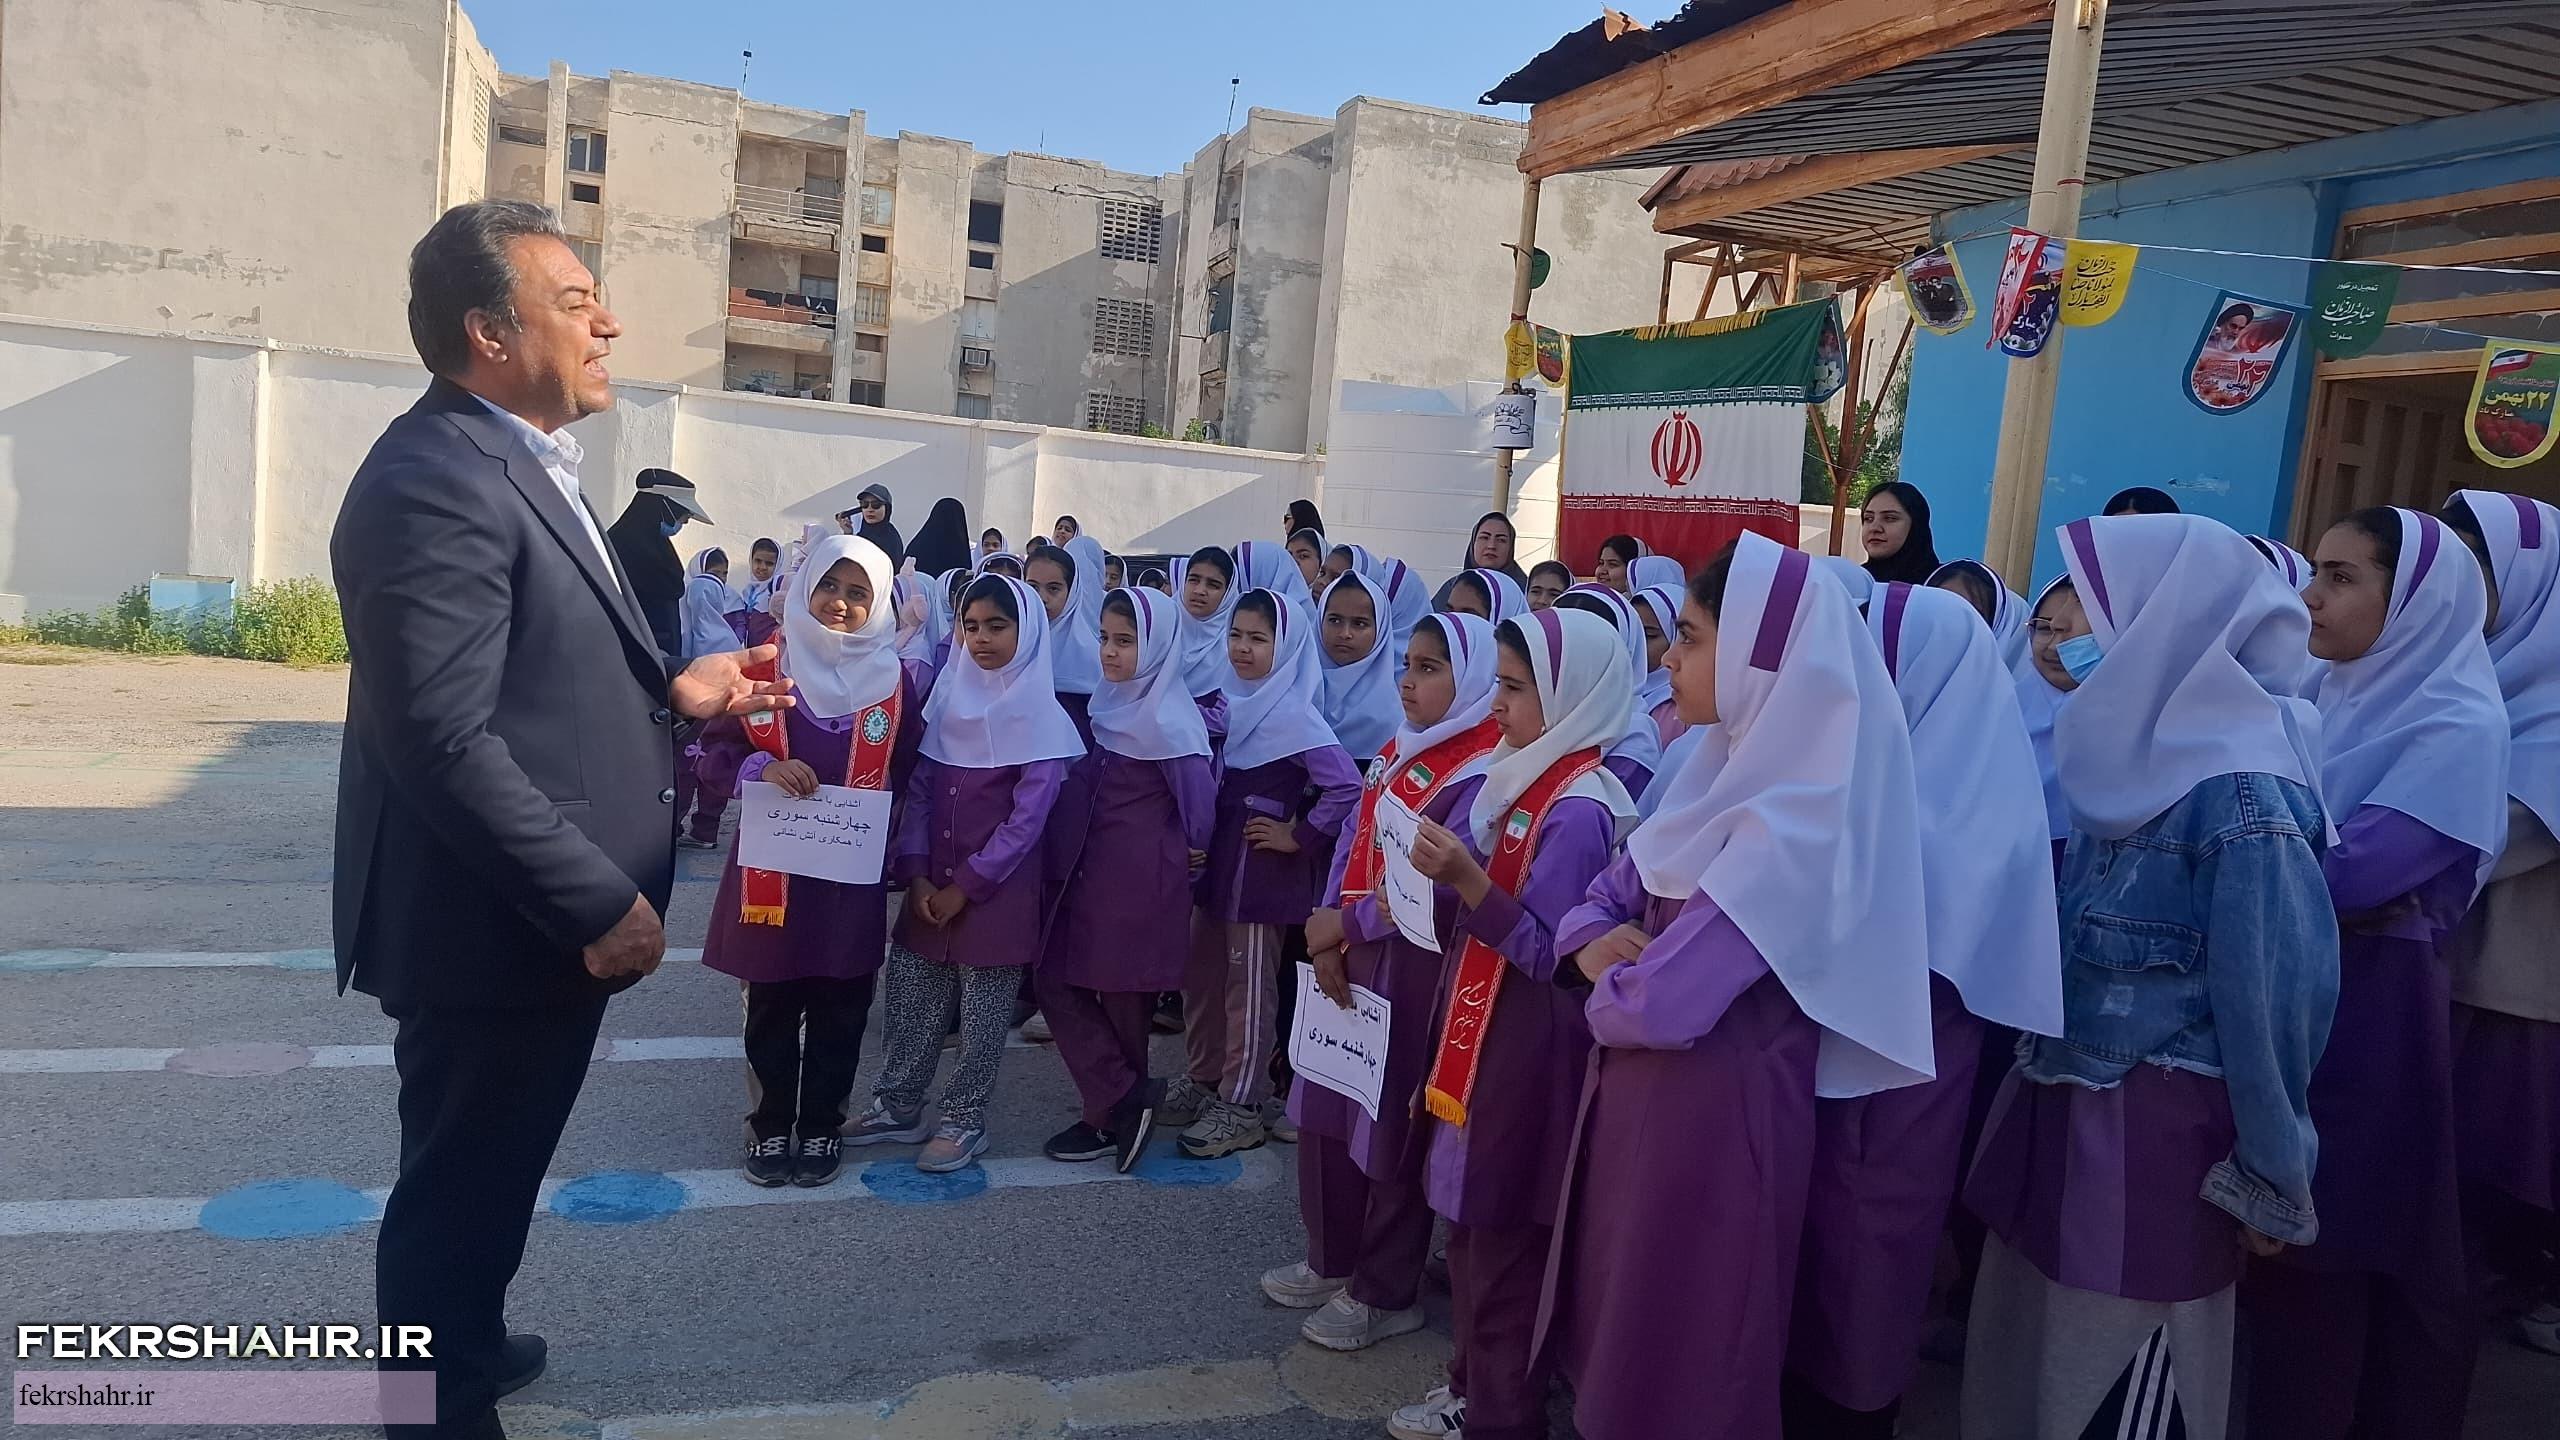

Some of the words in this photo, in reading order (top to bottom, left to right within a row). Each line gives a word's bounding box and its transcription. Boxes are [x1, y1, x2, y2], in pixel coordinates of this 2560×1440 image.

[2485, 390, 2525, 408] بهمن
[2527, 390, 2551, 410] ۲۲
[767, 808, 809, 822] سوری
[813, 812, 872, 834] چهارشنبه
[1309, 1027, 1338, 1048] سوری
[1341, 1039, 1377, 1079] چهارشنبه
